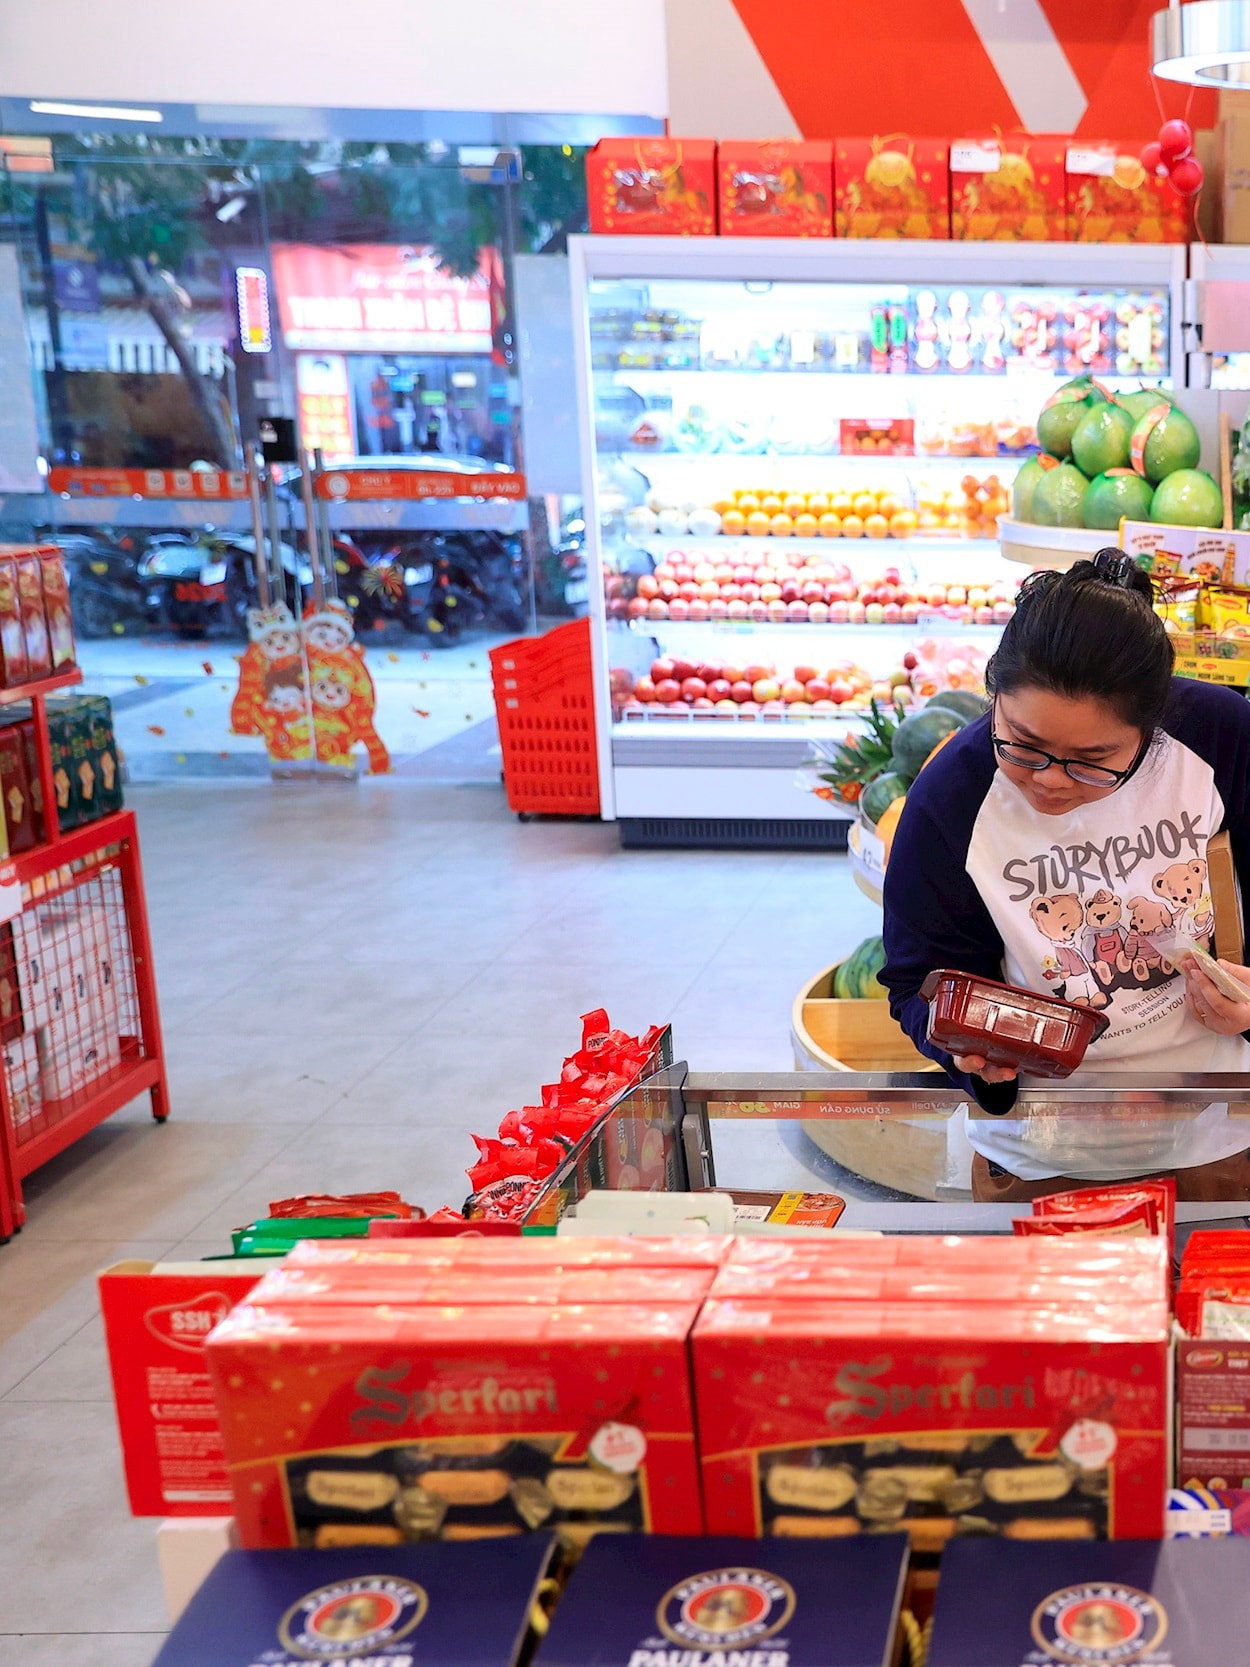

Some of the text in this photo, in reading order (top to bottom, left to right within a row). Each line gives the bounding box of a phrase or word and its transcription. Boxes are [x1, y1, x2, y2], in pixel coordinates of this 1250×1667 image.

[1121, 981, 1173, 1015] STORY-TELLING
[1138, 995, 1169, 1018] SESSION
[1100, 998, 1184, 1041] WANTS TO TELL YOU
